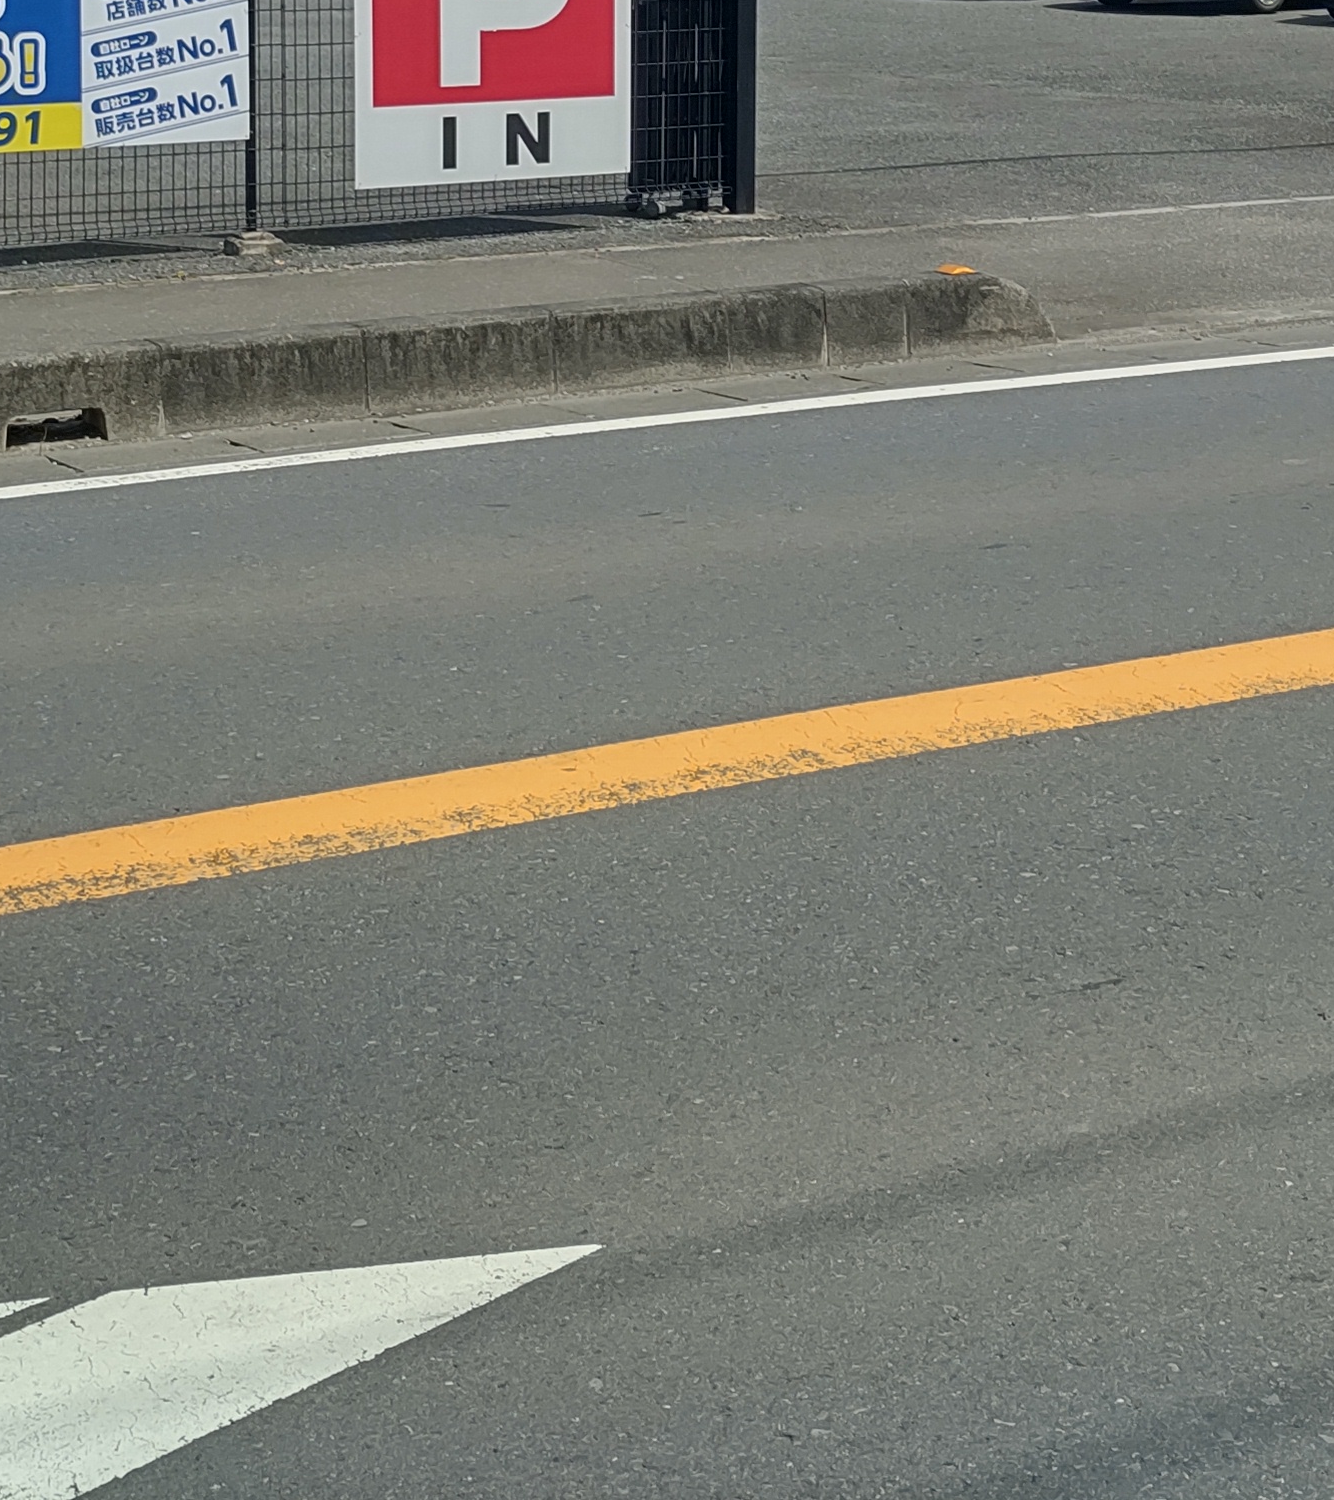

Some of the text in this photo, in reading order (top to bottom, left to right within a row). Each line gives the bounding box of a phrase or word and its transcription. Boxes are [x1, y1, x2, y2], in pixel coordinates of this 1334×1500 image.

[94, 18, 239, 80] 取扱台数 No.1
[95, 74, 240, 138] 販売台数 No.1
